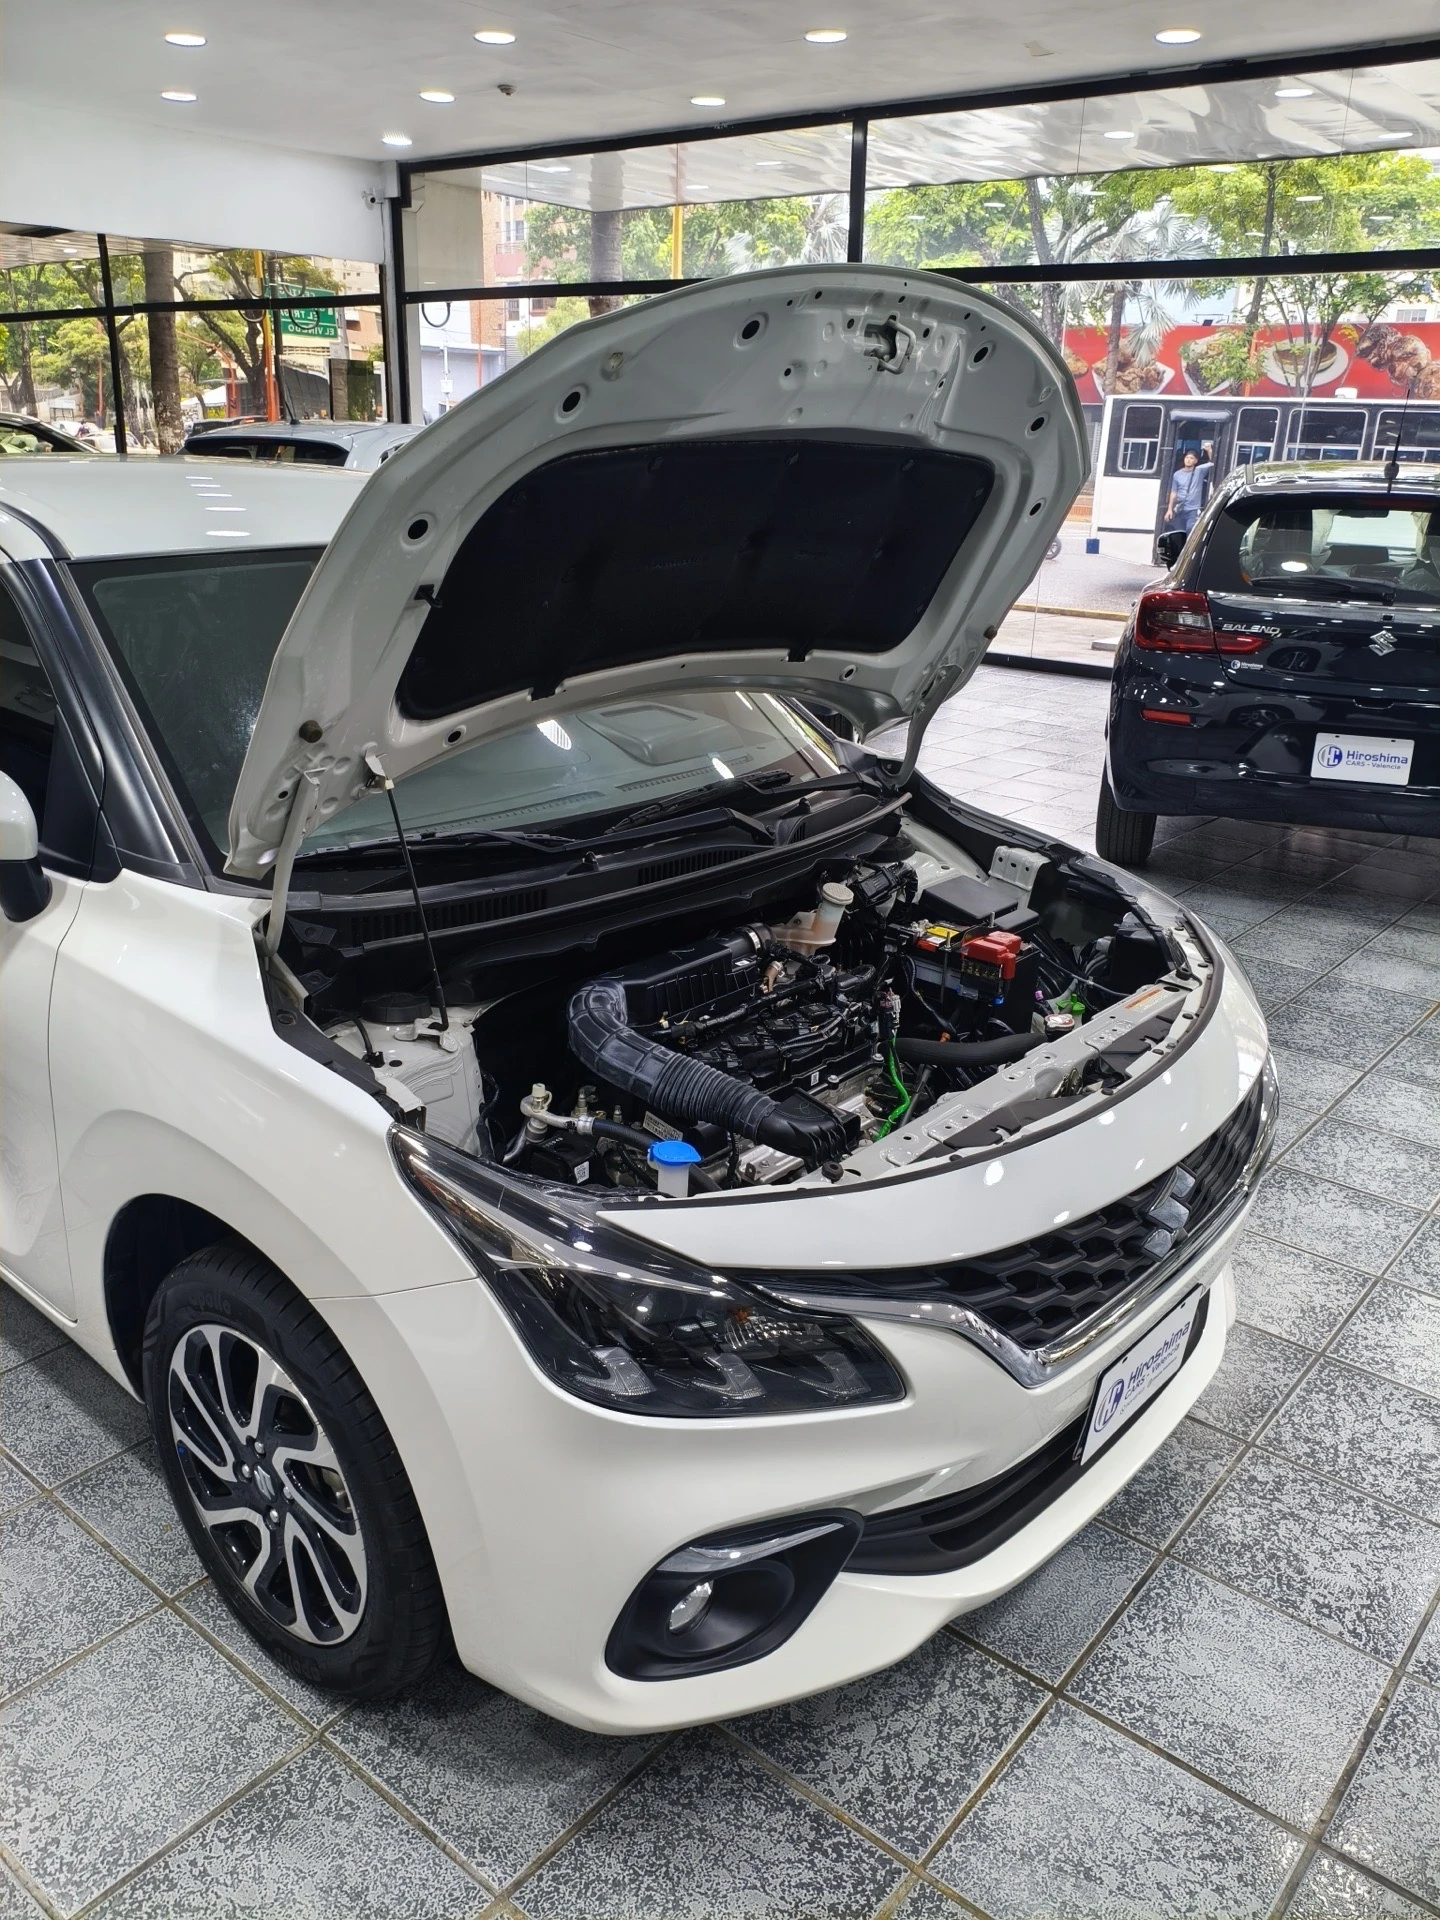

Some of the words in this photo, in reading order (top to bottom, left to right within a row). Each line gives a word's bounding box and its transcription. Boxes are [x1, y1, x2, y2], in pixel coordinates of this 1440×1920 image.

[1221, 623, 1282, 635] BALENO
[1346, 750, 1408, 764] Hiroshima
[1345, 759, 1365, 767] CARS
[1371, 762, 1401, 770] Valencia
[1127, 1321, 1190, 1389] Hiroshima
[1125, 1375, 1146, 1400] CARS
[1151, 1343, 1180, 1374] Valencia
